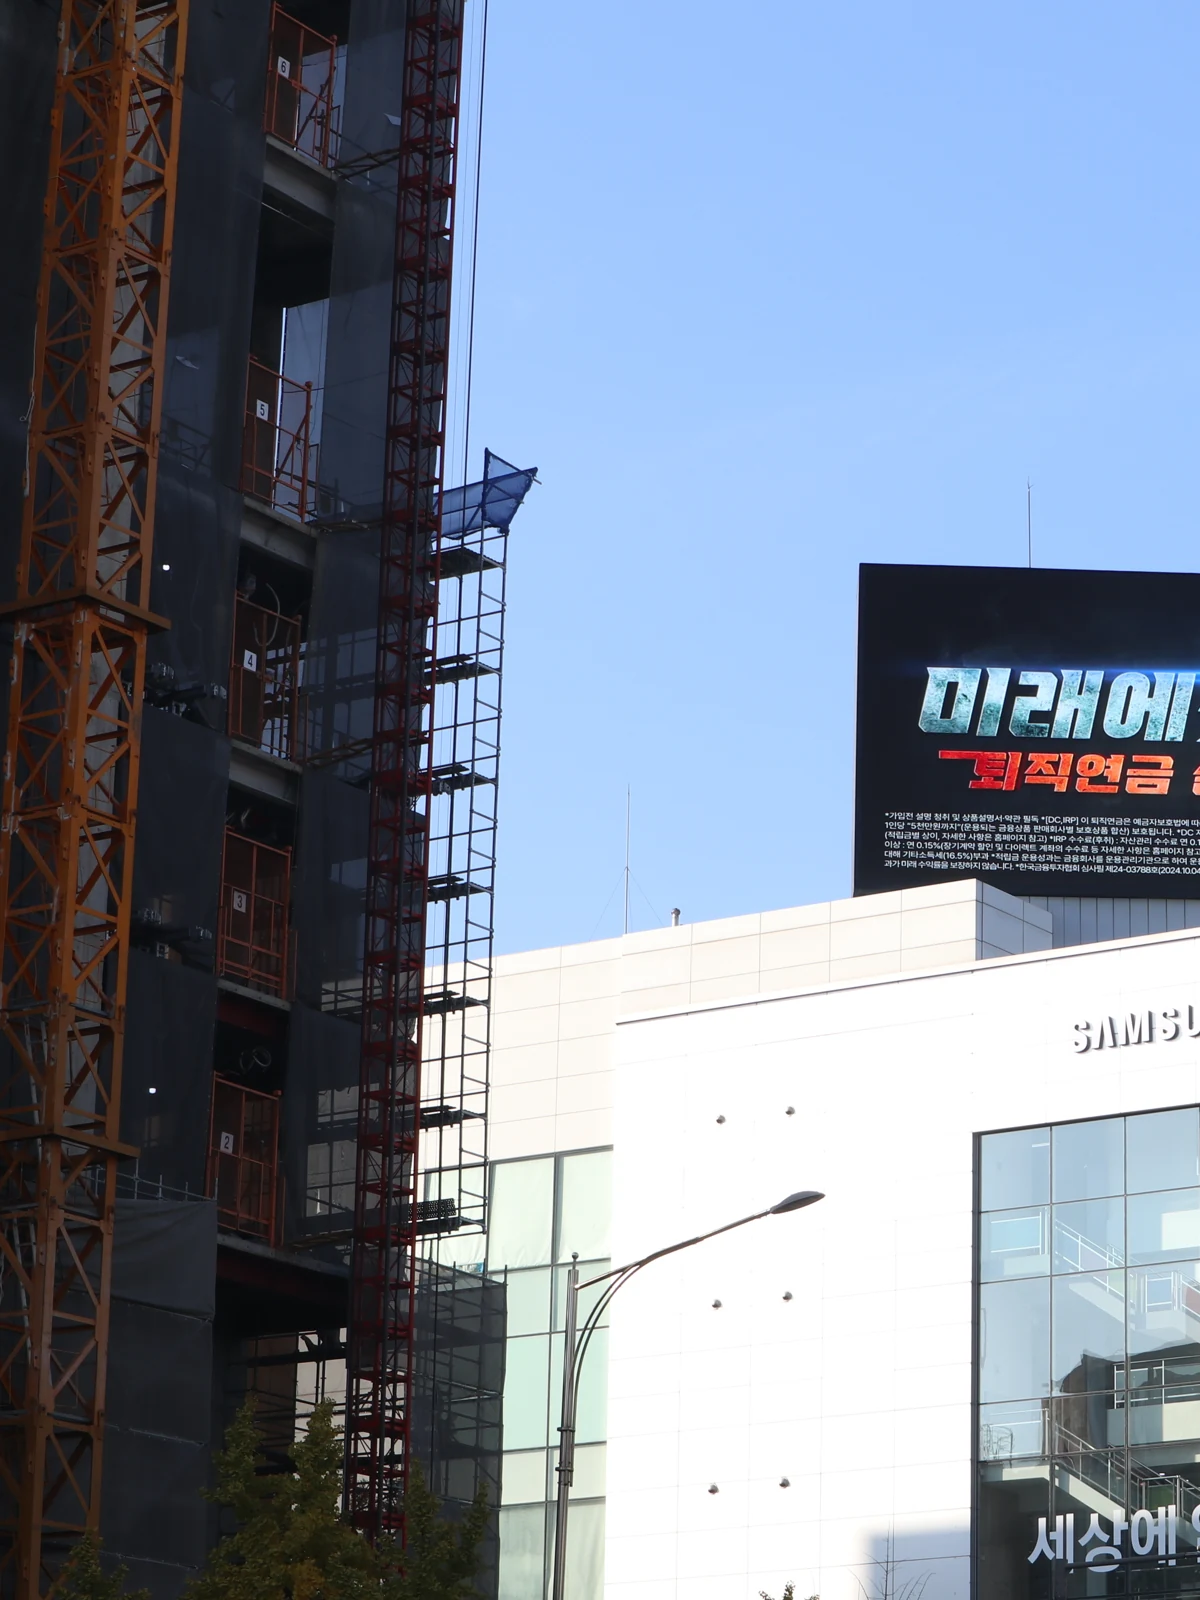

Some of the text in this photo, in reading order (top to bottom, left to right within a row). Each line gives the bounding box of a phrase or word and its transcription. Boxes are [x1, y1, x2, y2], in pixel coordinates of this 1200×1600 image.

[280, 60, 287, 73] 6
[260, 404, 265, 416] 5
[247, 654, 253, 667] 4
[938, 750, 1174, 795] 퇴직연금
[915, 812, 931, 821] 설명
[951, 813, 960, 821] 및
[1080, 816, 1088, 824] 이
[1090, 817, 1131, 825] 퇴직연금은
[1132, 818, 1189, 827] 예금자보호법에
[884, 821, 905, 830] 1인당
[998, 824, 1031, 833] 금융상품
[1033, 825, 1073, 834] 판매회사별
[1075, 826, 1108, 834] 보호상품
[1131, 827, 1174, 836] 보호됩니다.
[884, 831, 919, 840] (적립금별
[921, 832, 939, 840] 상이,
[941, 832, 966, 841] 자세한
[967, 833, 992, 841] 사항은
[994, 833, 1026, 842] 홈페이지
[1028, 834, 1047, 843] 참고)
[1068, 835, 1114, 844] 수수료(후취)
[1119, 836, 1152, 845] 자산관리
[1153, 837, 1178, 846] 수수료
[1179, 838, 1187, 846] 연
[884, 840, 901, 849] 이상
[906, 841, 914, 849] 연
[977, 843, 993, 851] 할인
[994, 843, 1003, 851] 및
[1004, 843, 1037, 852] 다이렉트
[1038, 844, 1063, 853] 계좌의
[1064, 845, 1089, 853] 수수료
[1090, 845, 1098, 853] 등
[1100, 845, 1124, 854] 자세한
[1126, 846, 1150, 855] 사항은
[1152, 847, 1184, 855] 홈페이지
[883, 850, 900, 858] 대해
[1020, 853, 1061, 862] 운용성과는
[1063, 854, 1103, 863] 금융회사를
[1171, 857, 1187, 865] 하여
[883, 860, 900, 868] 과가
[900, 860, 917, 868] 미래
[917, 861, 948, 869] 수익률을
[949, 861, 980, 869] 보장하지
[981, 862, 1014, 870] 않습니다.
[237, 895, 243, 908] 3
[224, 1136, 230, 1149] 2
[1027, 1505, 1176, 1573] 세상에
